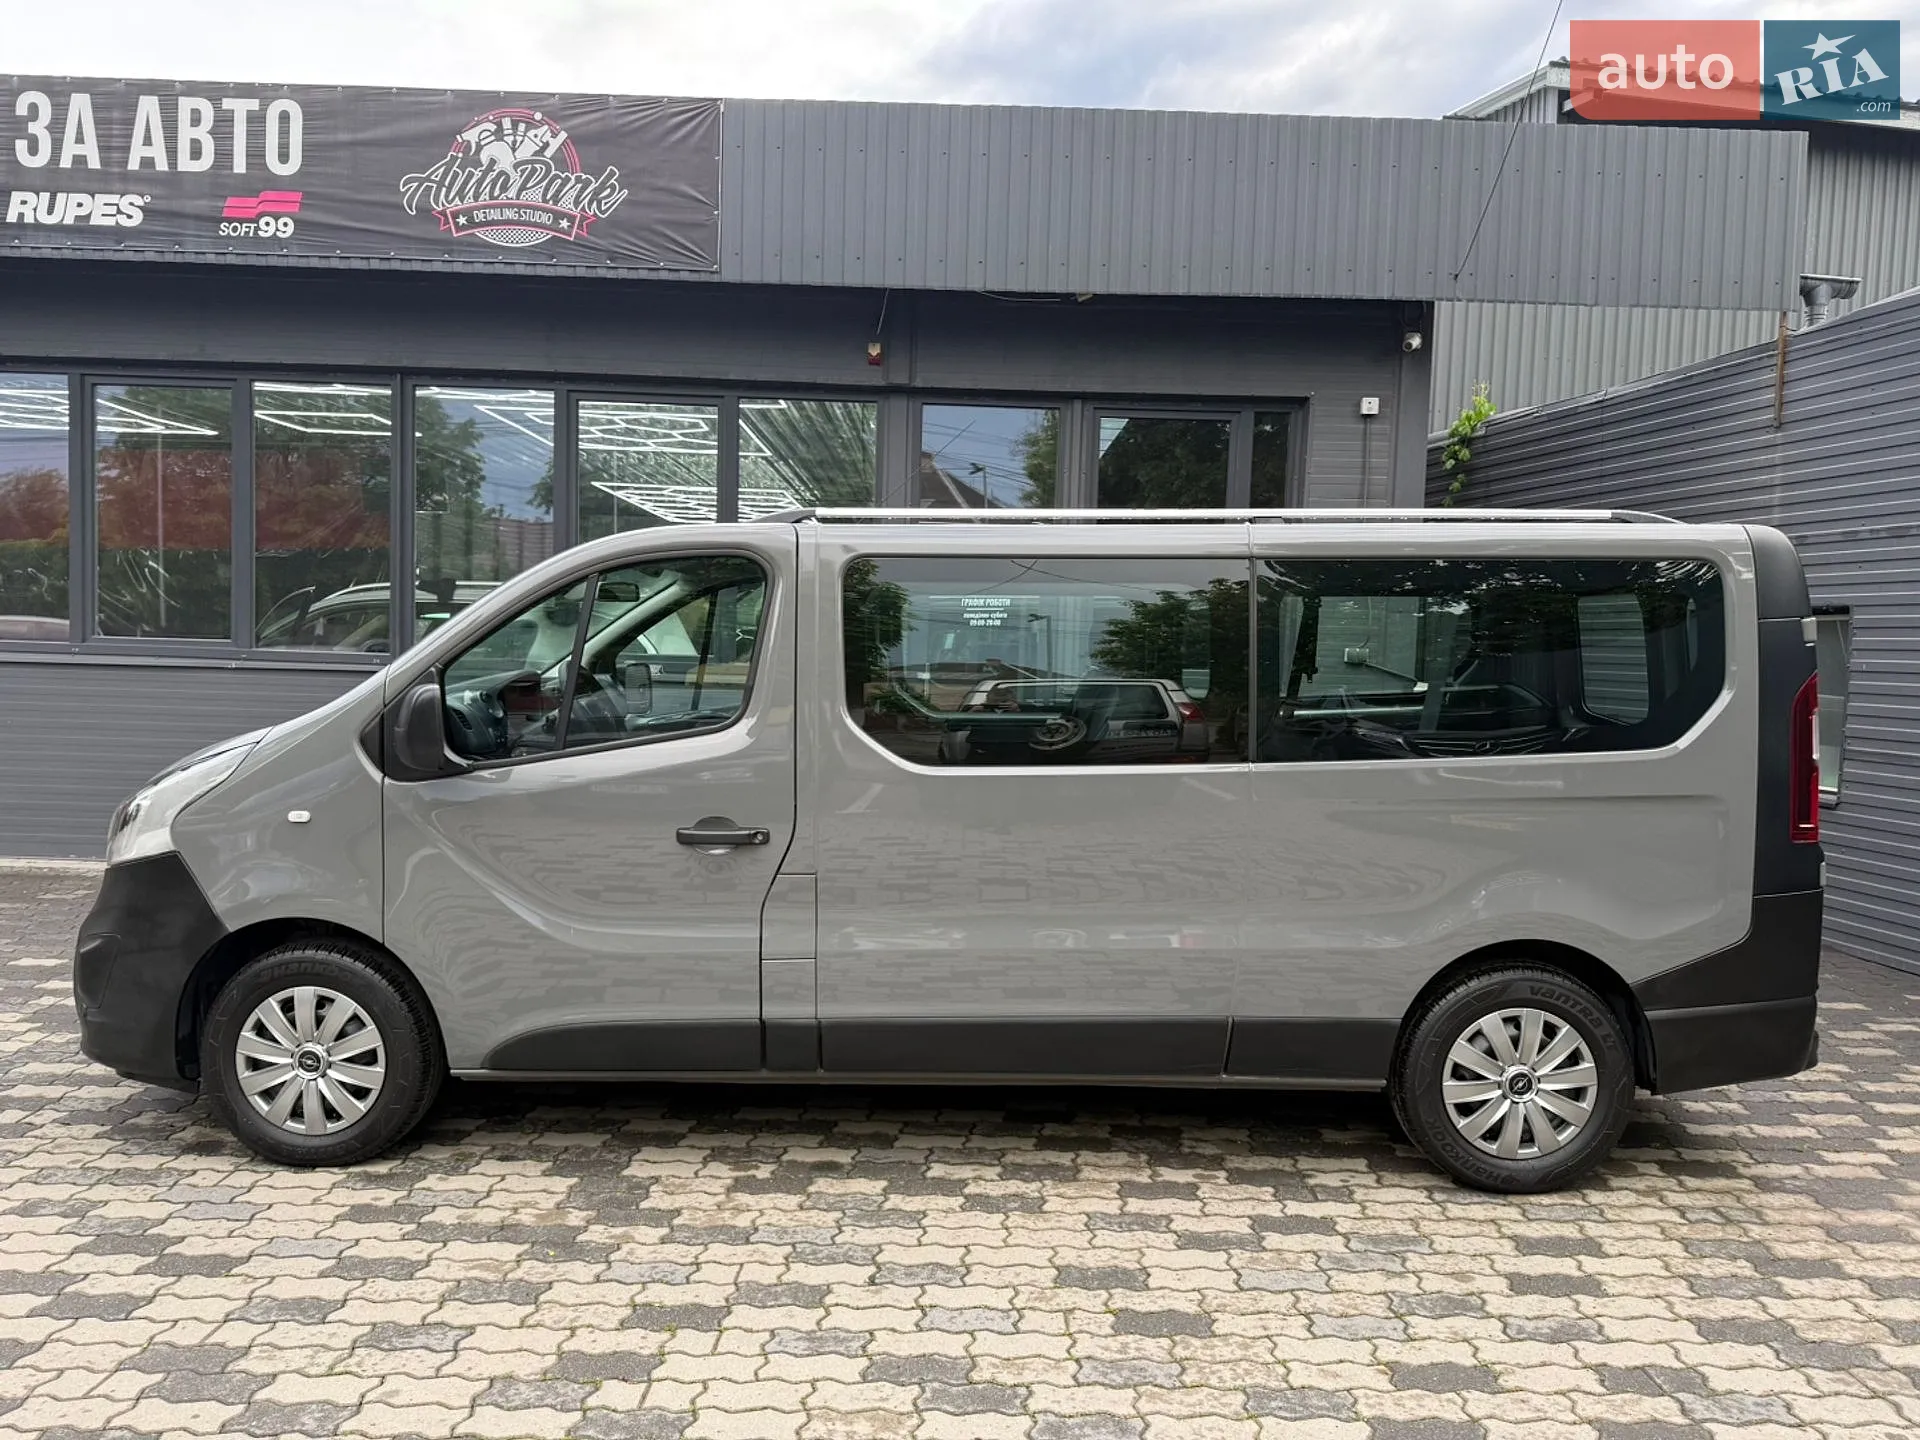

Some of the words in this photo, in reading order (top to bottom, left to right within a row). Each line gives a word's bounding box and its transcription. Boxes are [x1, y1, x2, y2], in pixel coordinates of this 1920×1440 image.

[14, 90, 101, 170] ЗА
[126, 95, 303, 176] АВТО
[473, 208, 519, 221] DETAILING
[520, 209, 554, 225] STUDIO
